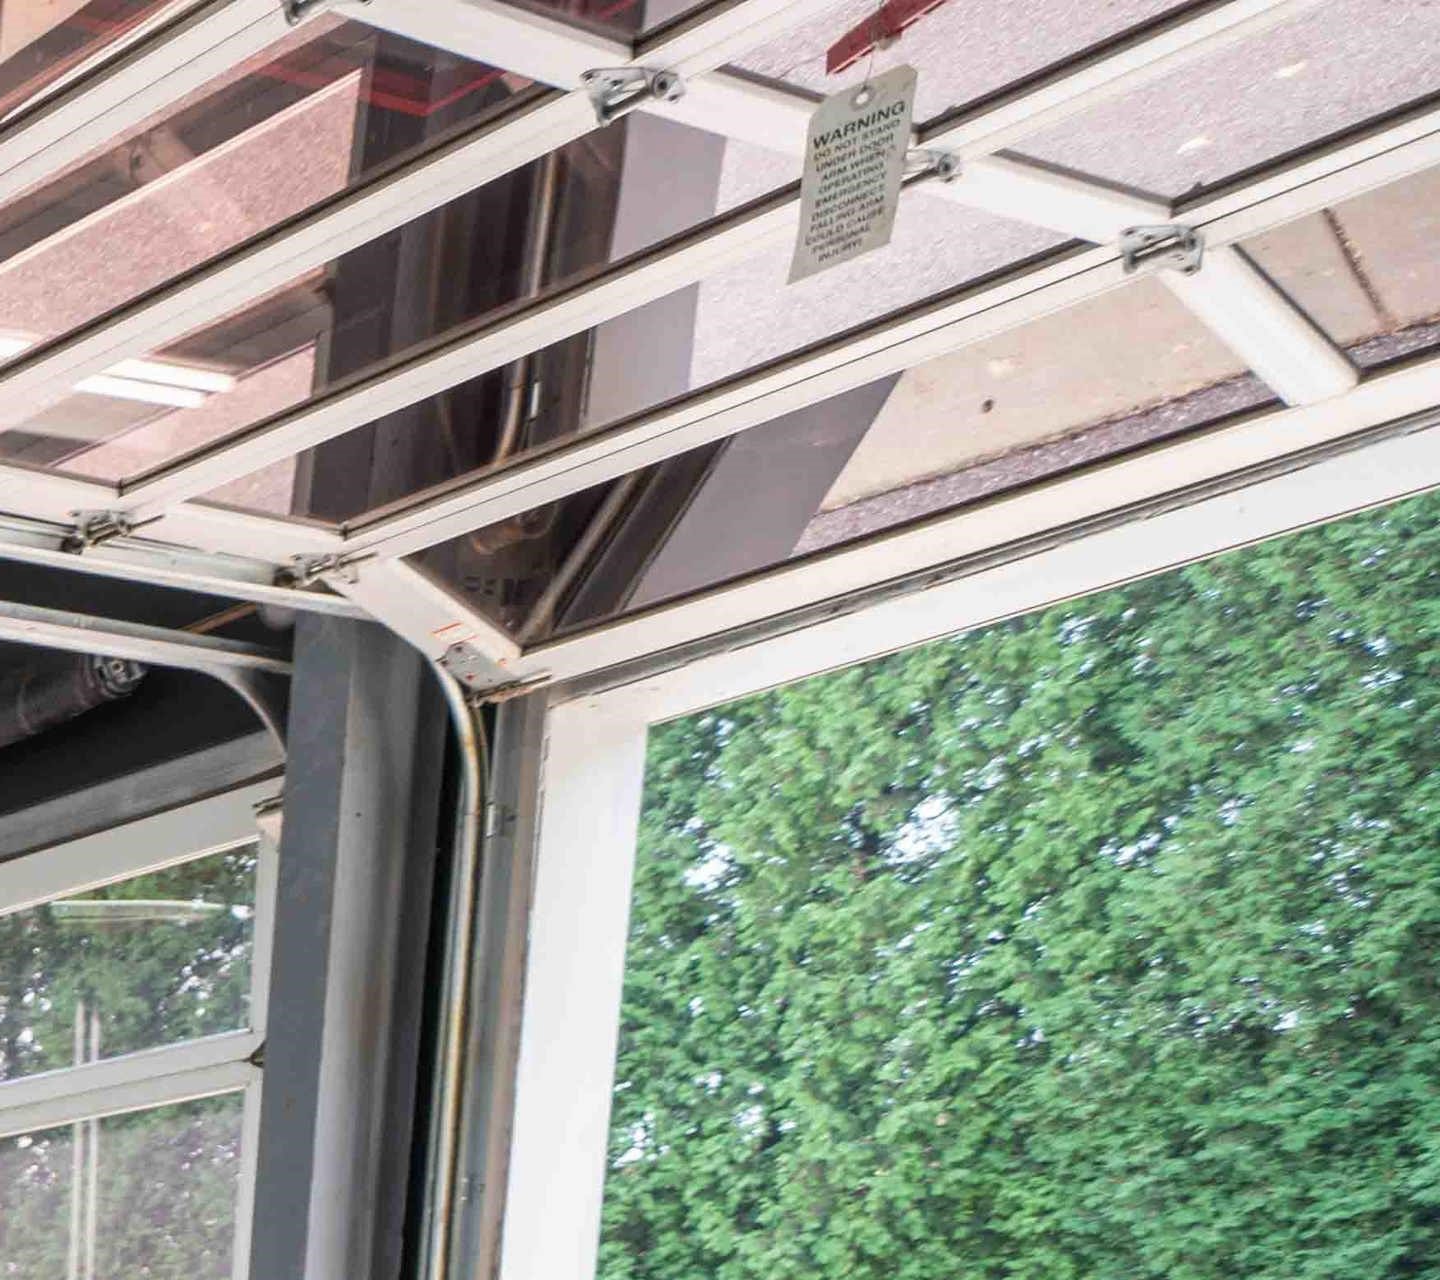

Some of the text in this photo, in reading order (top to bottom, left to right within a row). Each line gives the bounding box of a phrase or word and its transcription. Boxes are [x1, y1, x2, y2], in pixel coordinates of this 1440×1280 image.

[813, 100, 905, 149] WARNING
[813, 116, 900, 160] DO NOT STAND
[815, 131, 894, 172] UNDER DOOR
[821, 147, 885, 181] ARM WHEN
[814, 170, 886, 207] EMERGENCY
[817, 159, 884, 194] OPERATING
[810, 183, 884, 220] DISCONNECT
[810, 194, 884, 231] FALLING ARM
